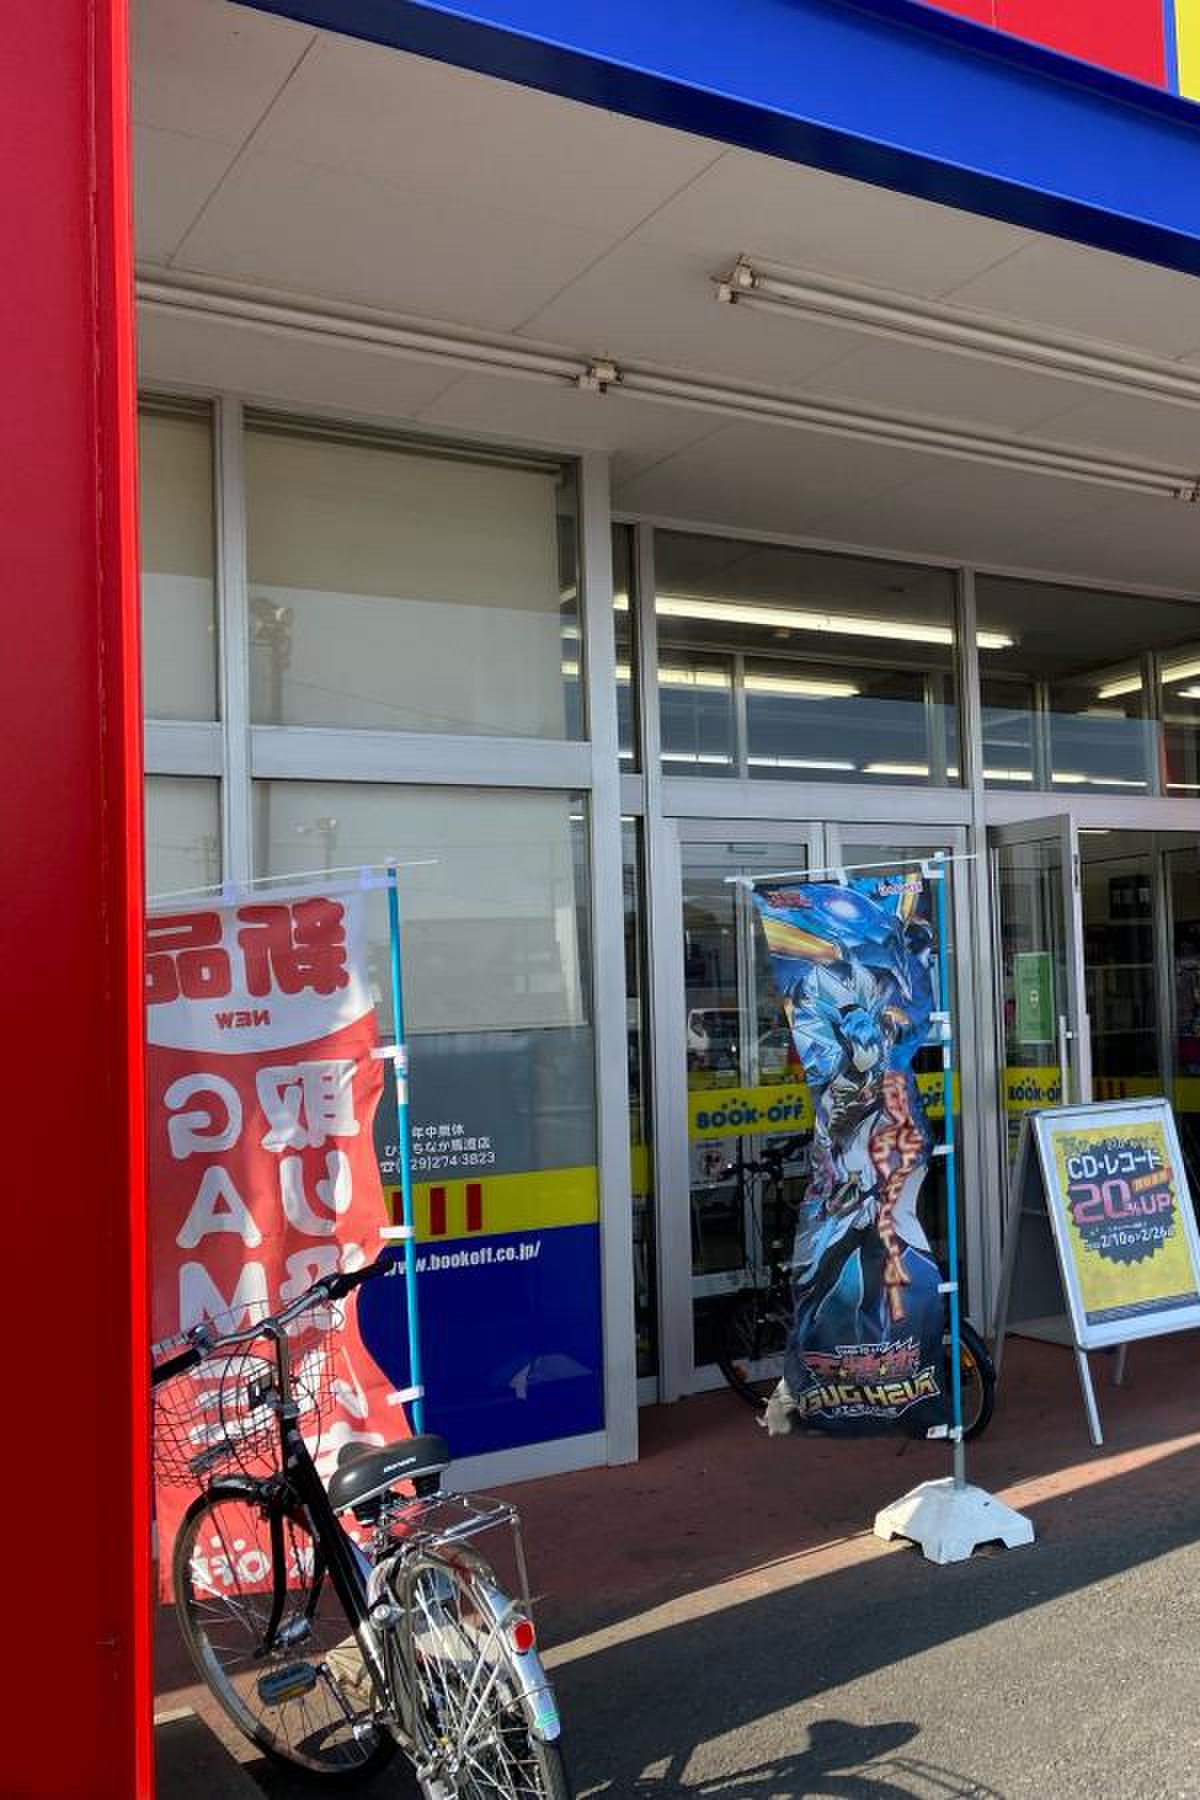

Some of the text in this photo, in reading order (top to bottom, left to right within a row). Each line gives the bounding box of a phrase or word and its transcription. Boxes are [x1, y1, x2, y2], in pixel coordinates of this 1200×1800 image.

[384, 1137, 491, 1156] ひちなか馬渡店
